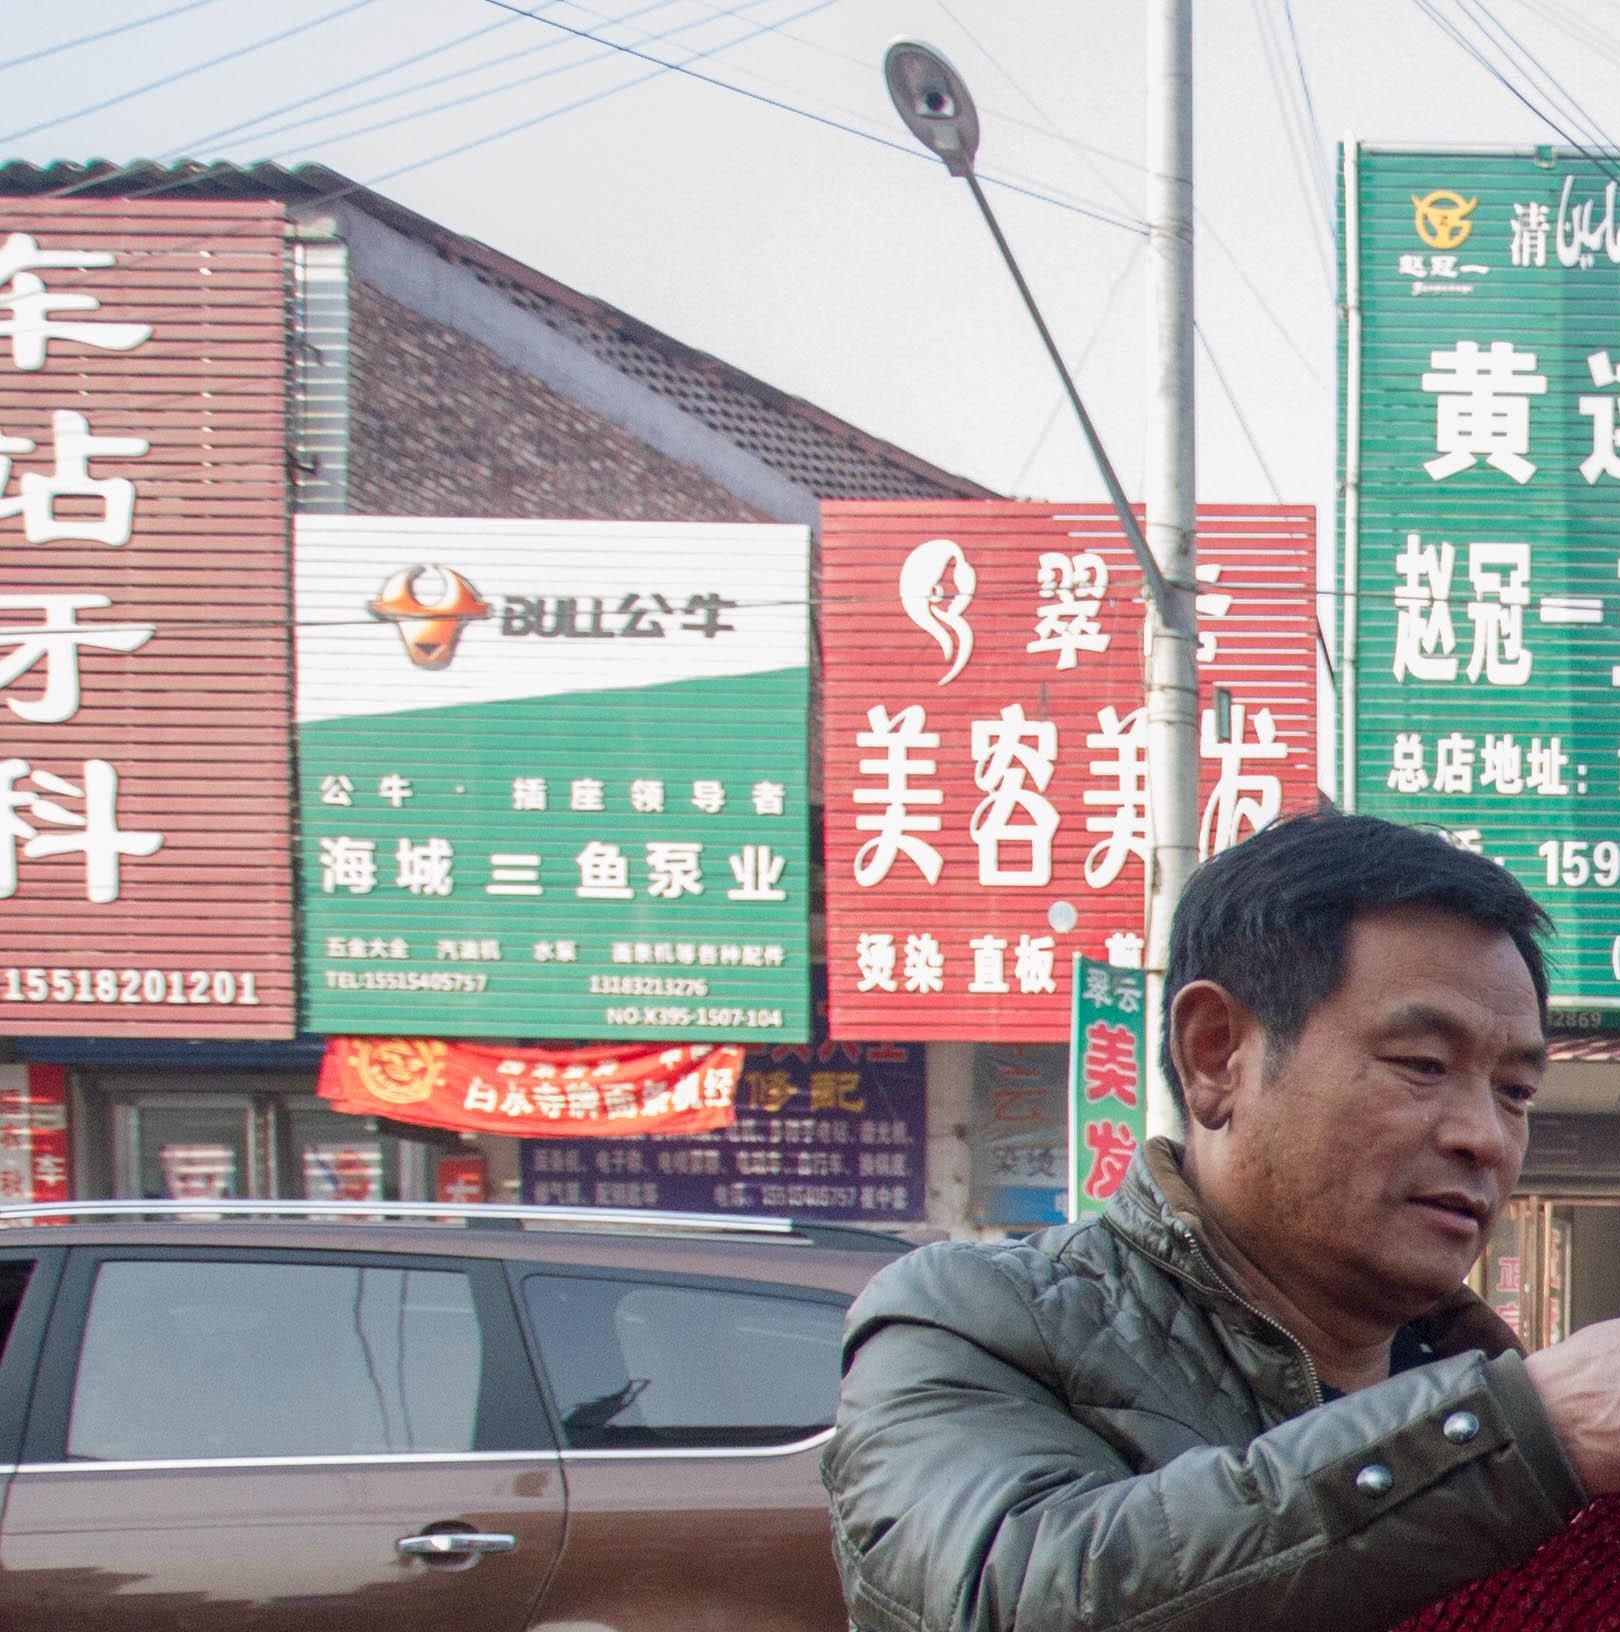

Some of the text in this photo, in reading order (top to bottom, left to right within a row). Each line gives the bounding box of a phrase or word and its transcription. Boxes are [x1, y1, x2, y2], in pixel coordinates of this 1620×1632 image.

[318, 836, 788, 901] 海城三鱼泵业
[4, 969, 260, 1006] 15518201201
[856, 933, 944, 993] 烫染
[967, 935, 1056, 993] 直板
